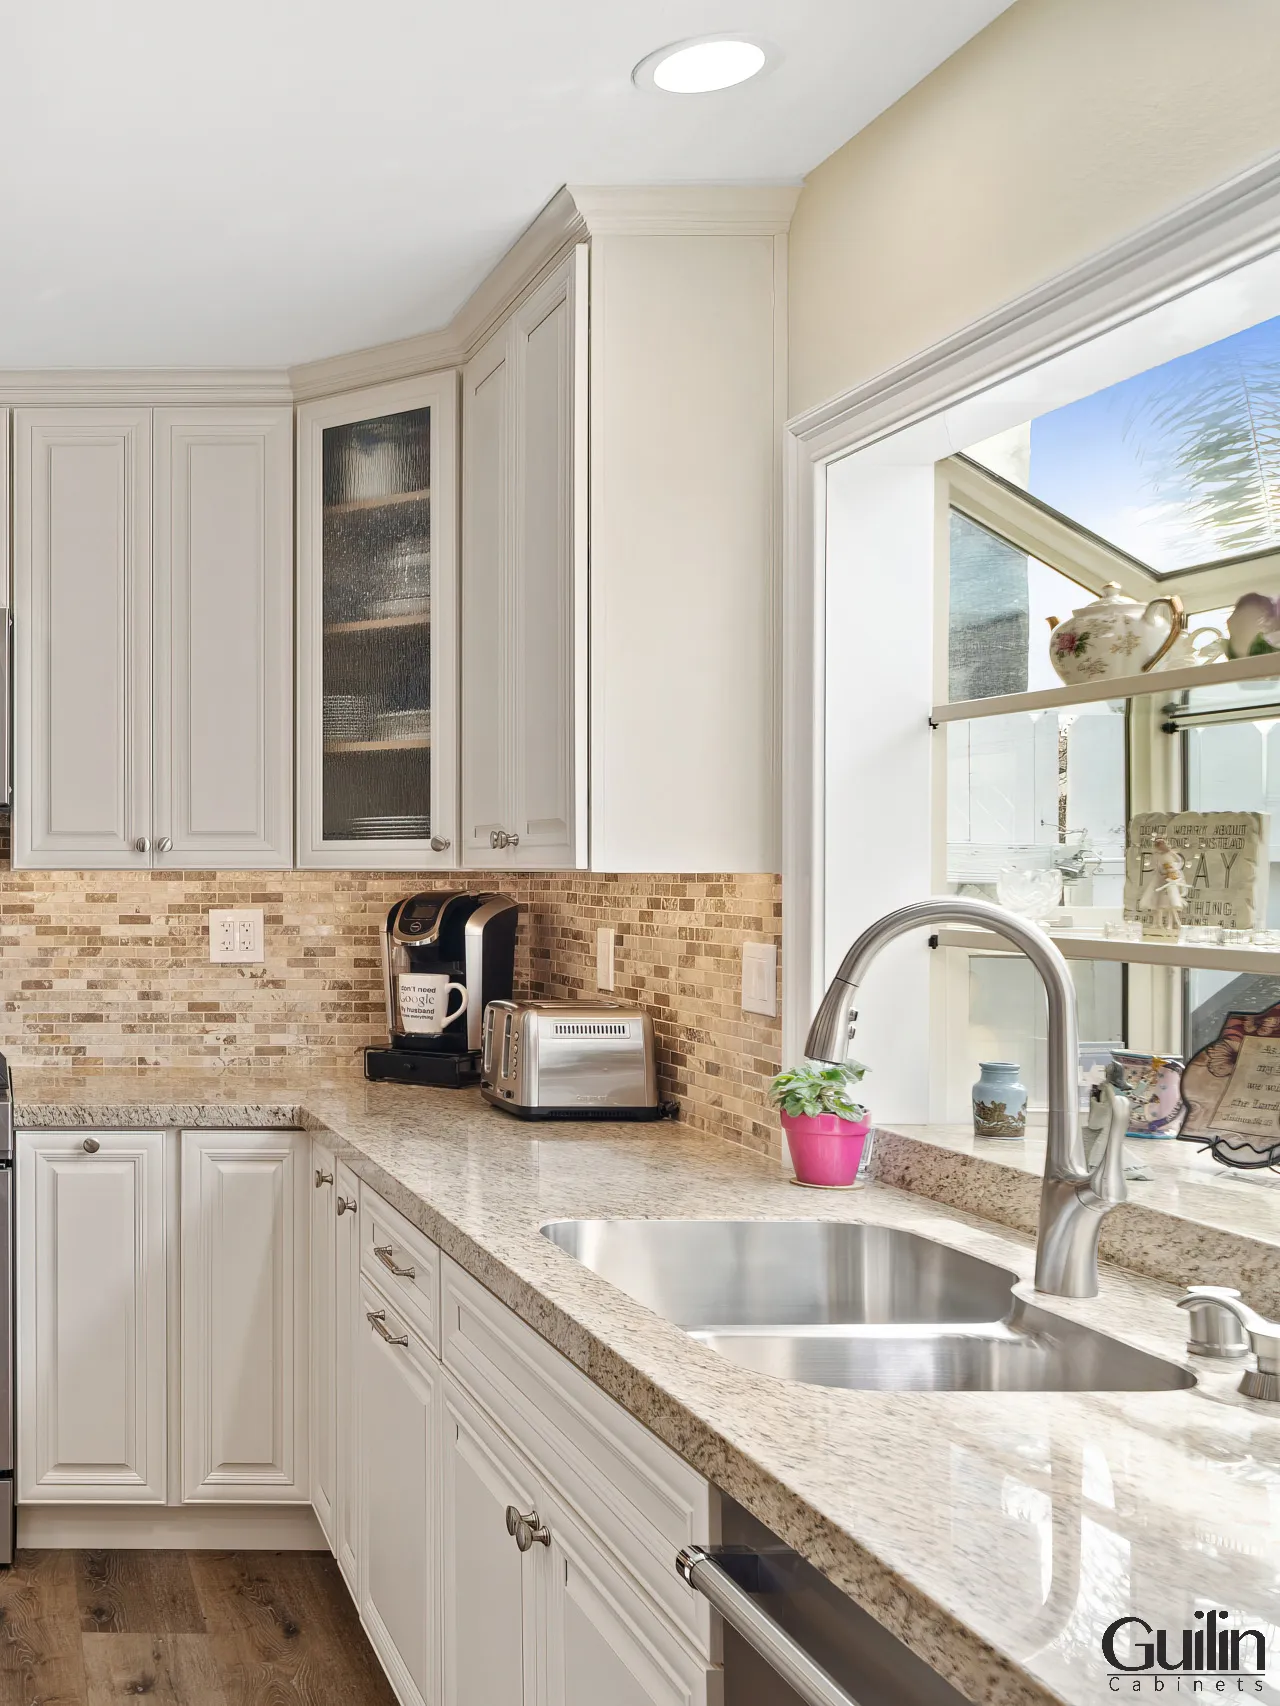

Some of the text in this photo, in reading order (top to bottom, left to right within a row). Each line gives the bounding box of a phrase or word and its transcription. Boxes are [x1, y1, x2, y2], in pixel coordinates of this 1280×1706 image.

[1173, 824, 1208, 836] WORRY
[1213, 824, 1248, 836] ABOUT
[1198, 837, 1246, 850] INSTEAD
[407, 1006, 435, 1014] husband
